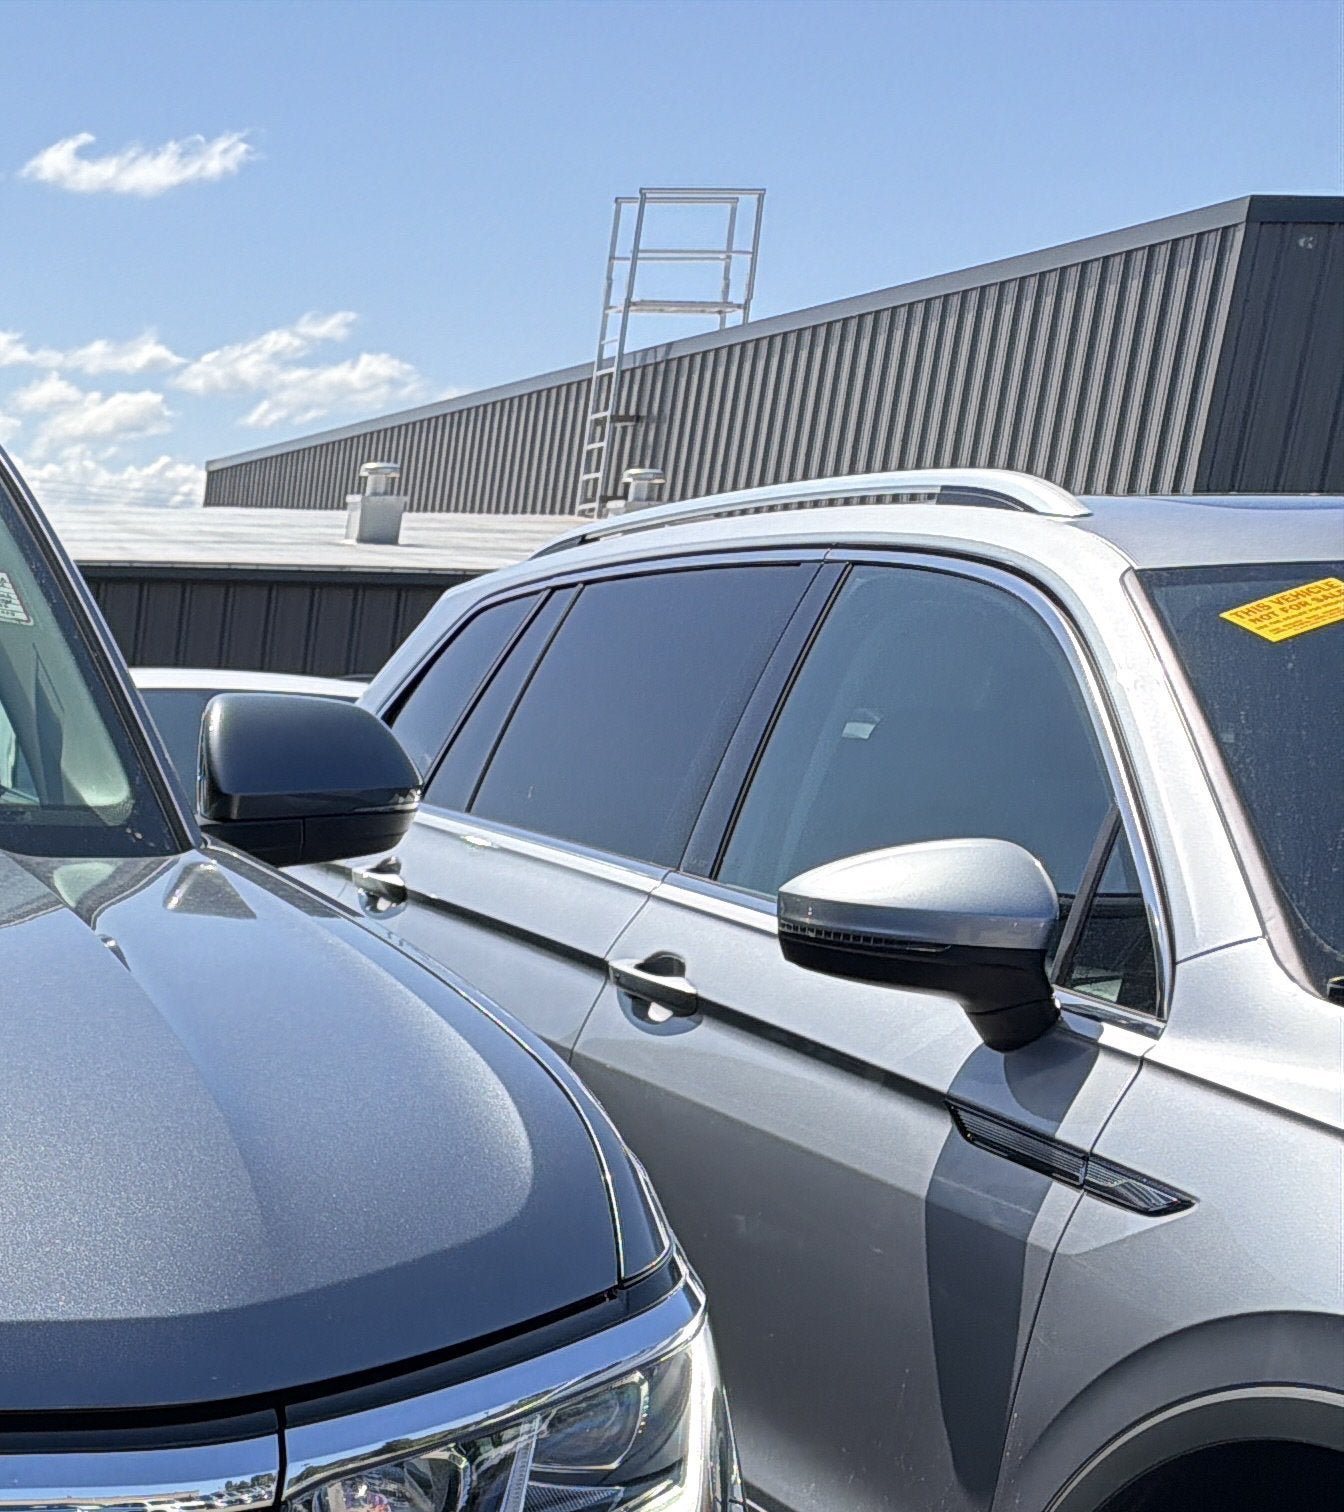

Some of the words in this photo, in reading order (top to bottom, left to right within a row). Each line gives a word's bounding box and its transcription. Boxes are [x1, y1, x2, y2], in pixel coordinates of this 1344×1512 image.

[1229, 602, 1272, 619] THIS
[1269, 580, 1339, 605] VEHICLE
[1248, 610, 1279, 624] NOT
[1278, 600, 1312, 613] FOR
